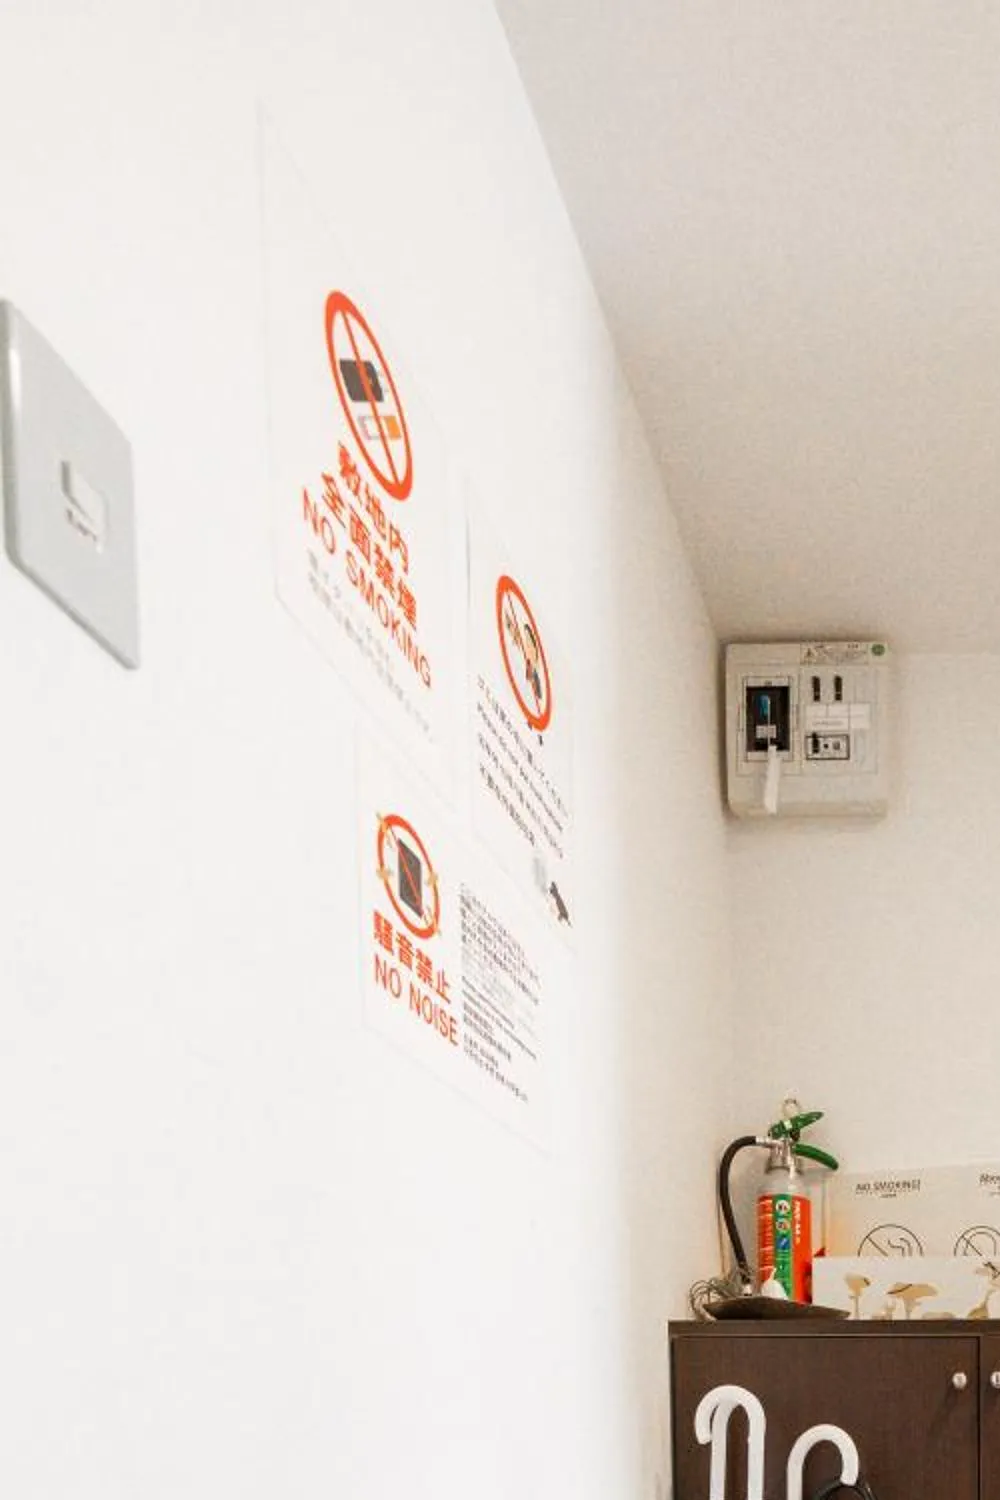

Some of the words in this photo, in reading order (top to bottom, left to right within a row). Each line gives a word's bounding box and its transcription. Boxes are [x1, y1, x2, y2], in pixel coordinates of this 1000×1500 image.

[321, 471, 417, 633] 全面禁煙
[338, 439, 409, 576] 敷地内
[303, 486, 336, 555] NO
[345, 549, 431, 689] SMOKING
[373, 909, 451, 1005] 騒音禁止
[374, 953, 402, 999] NO
[408, 980, 458, 1047] NOISE
